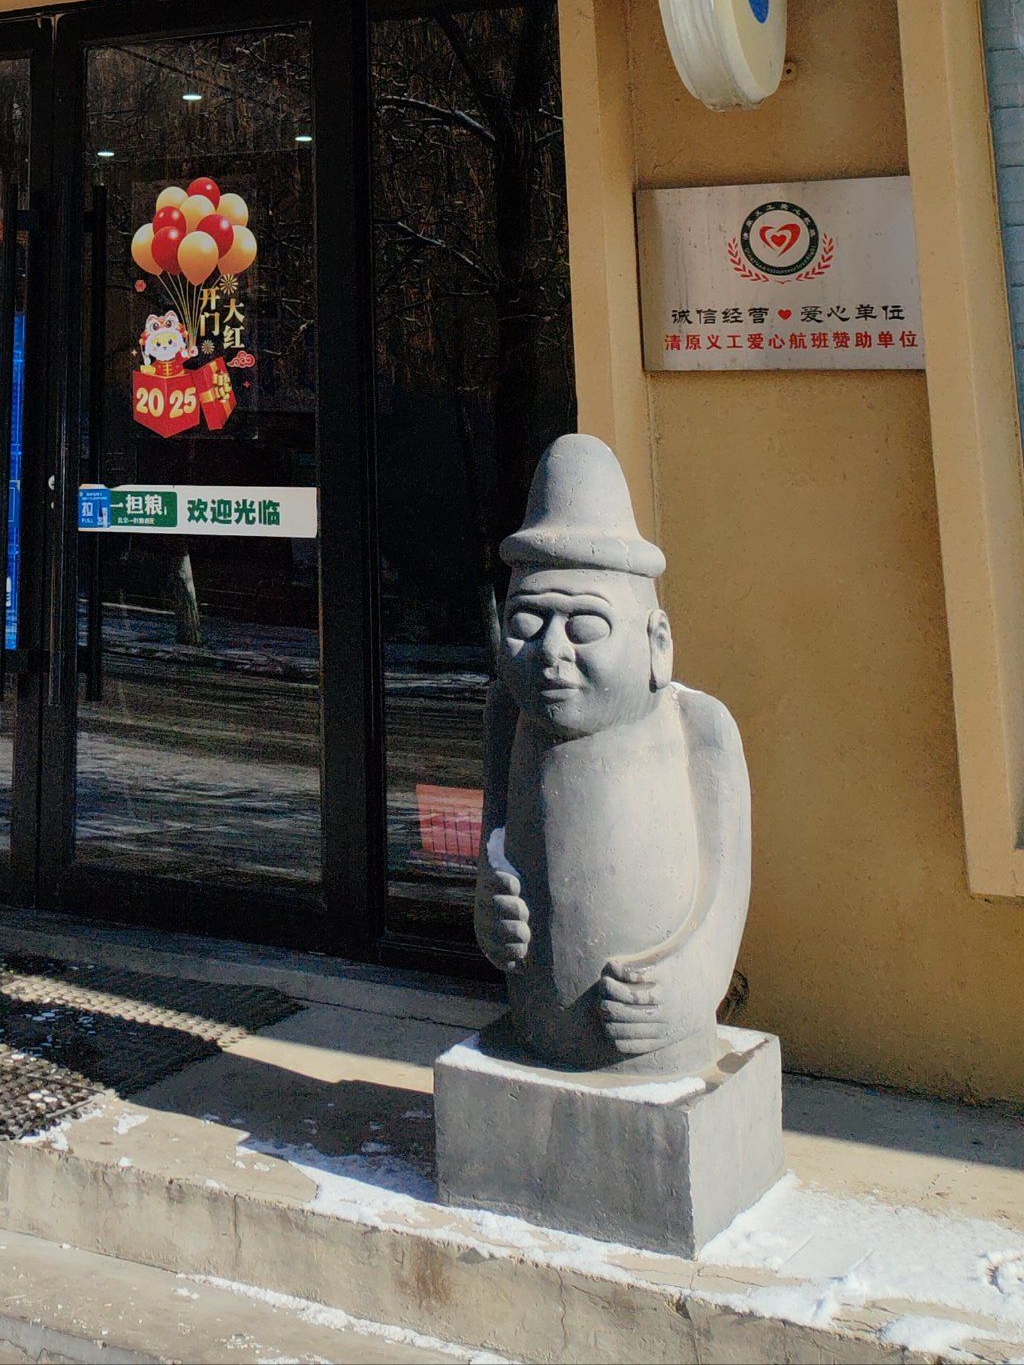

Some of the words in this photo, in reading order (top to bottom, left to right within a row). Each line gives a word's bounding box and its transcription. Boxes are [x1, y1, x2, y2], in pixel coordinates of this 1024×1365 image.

[672, 307, 770, 324] 诚信经营
[800, 304, 905, 324] 爱心单位
[664, 331, 919, 351] 清原义工爱心航班赞助单位
[110, 494, 163, 516] 一担粮
[187, 498, 280, 526] 欢迎光临
